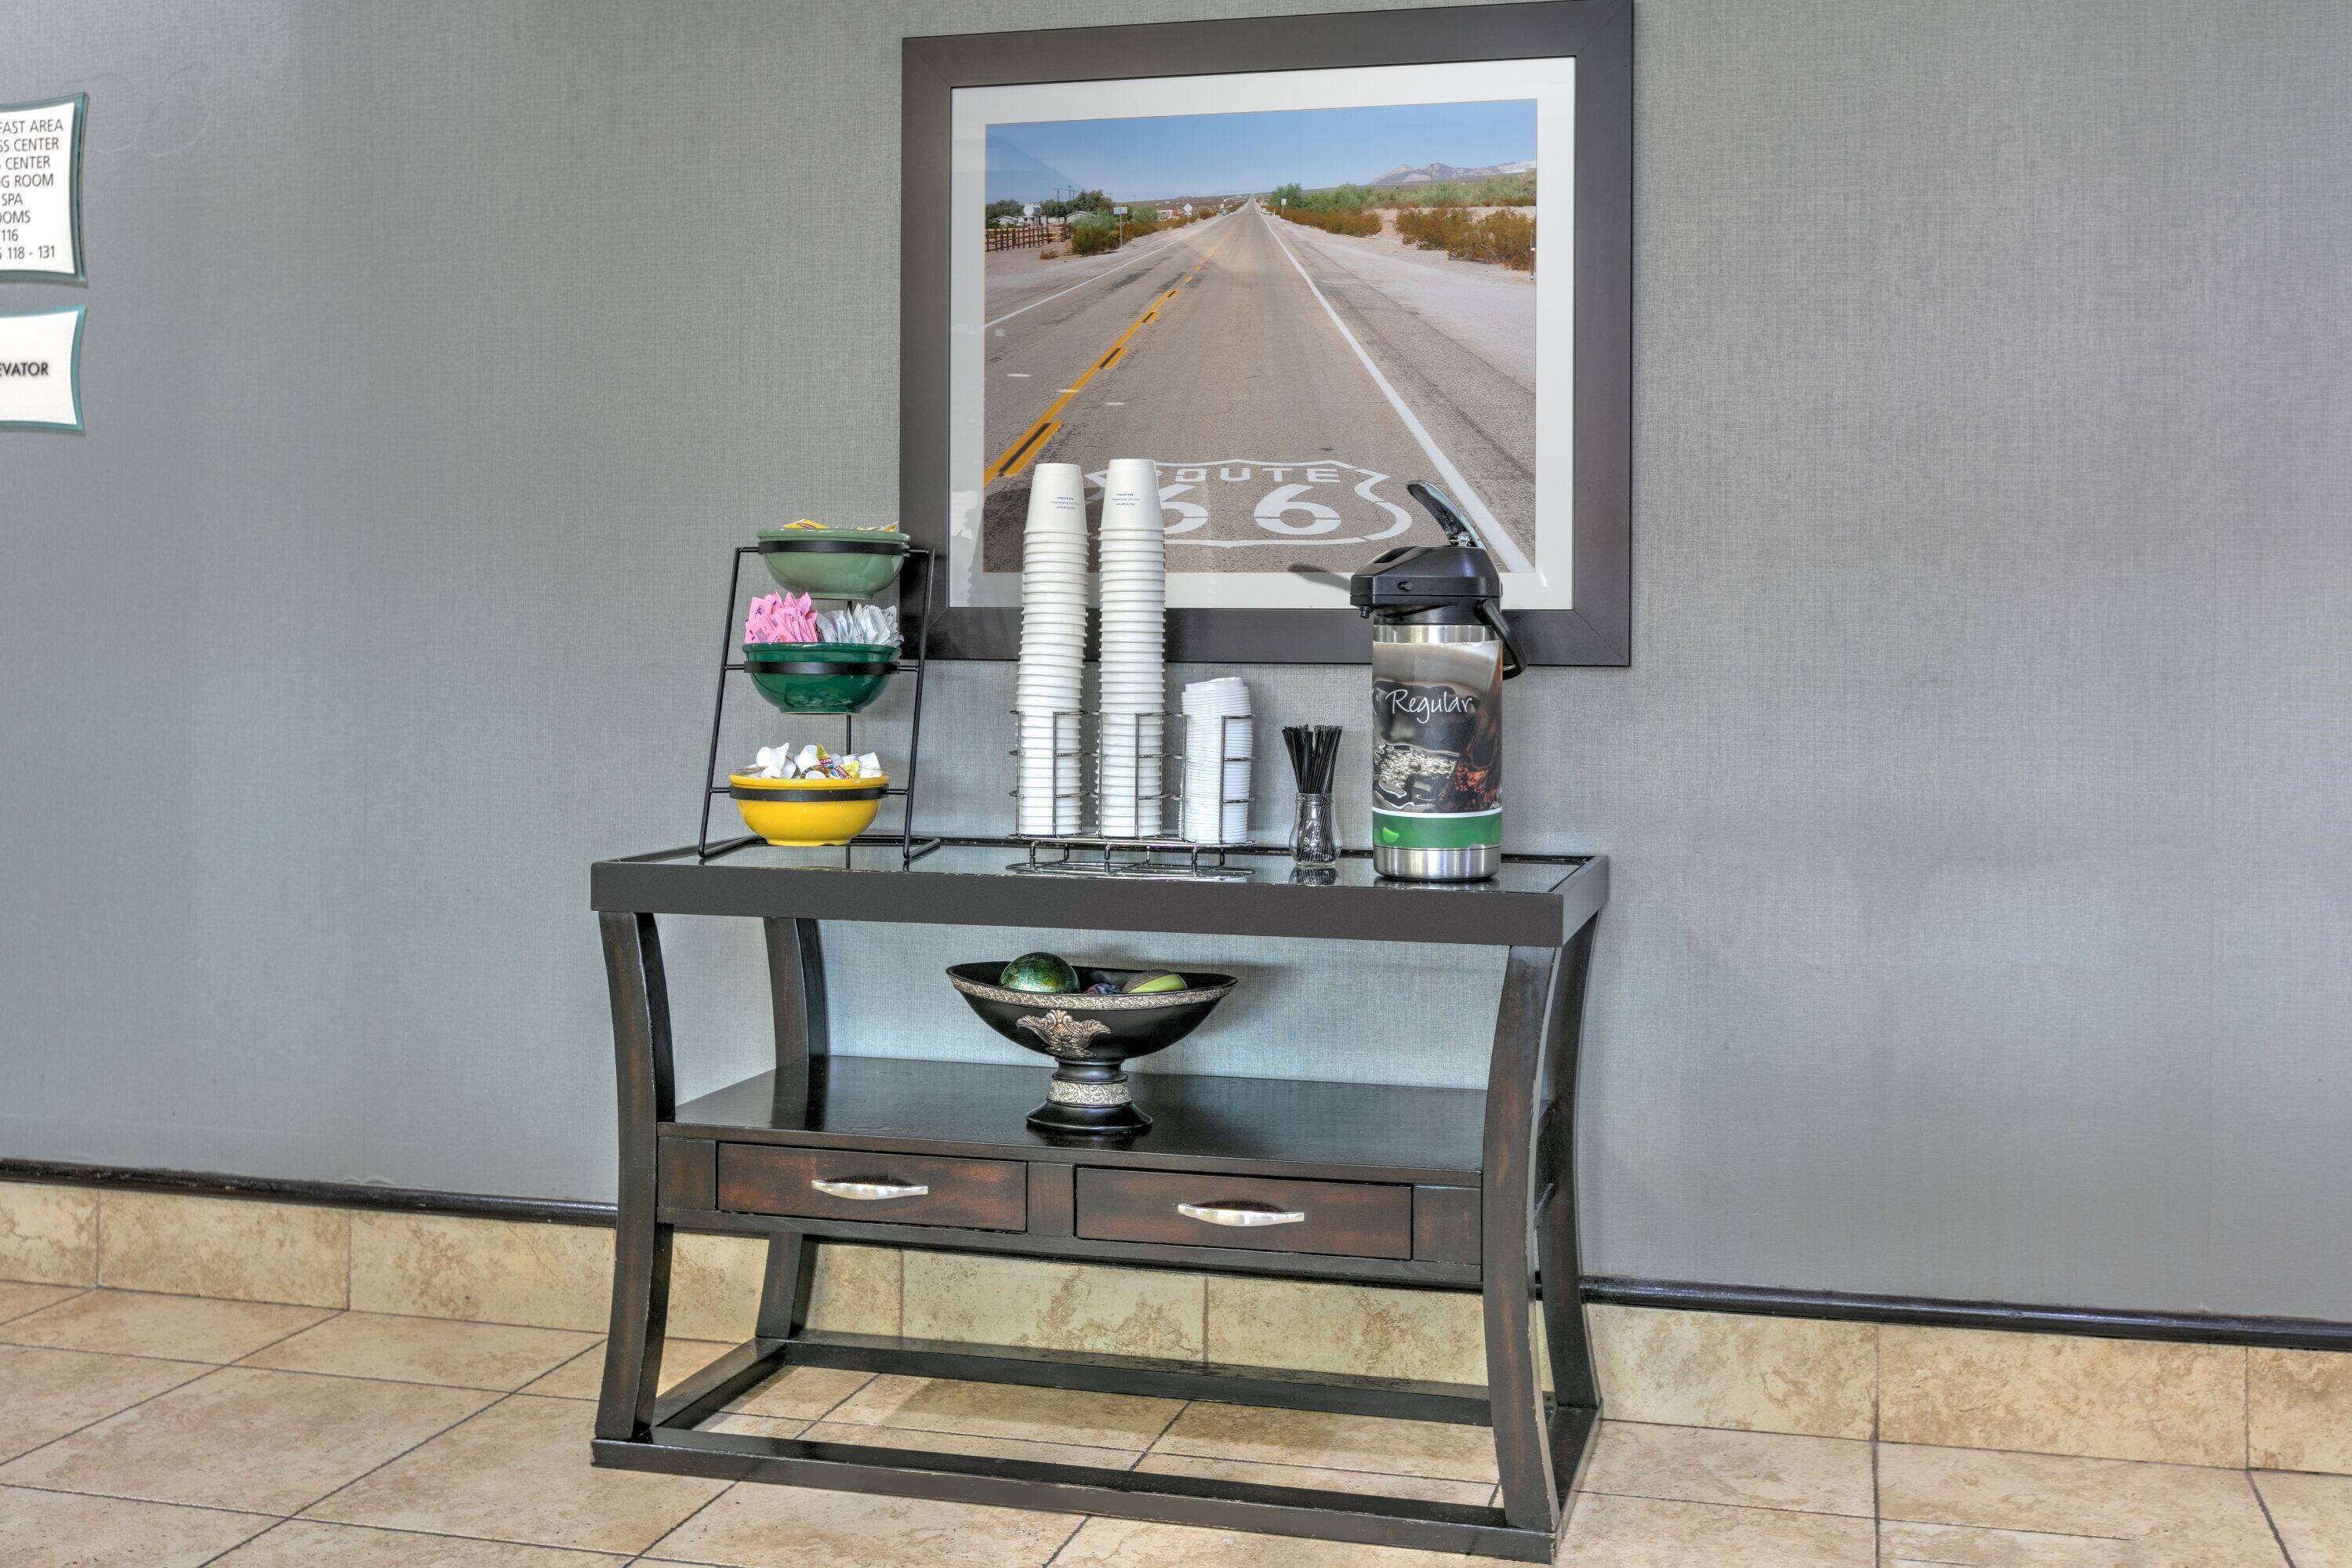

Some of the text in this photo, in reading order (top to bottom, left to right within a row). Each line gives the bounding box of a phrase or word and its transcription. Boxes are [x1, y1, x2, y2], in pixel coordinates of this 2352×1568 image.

[30, 118, 64, 132] AREA
[13, 136, 60, 152] CENTER
[5, 155, 51, 170] CENTER
[14, 173, 53, 187] ROOM
[2, 193, 24, 206] SPA
[0, 210, 31, 224] OMS
[1, 229, 19, 242] 116
[8, 246, 25, 260] 118
[38, 245, 55, 259] 131
[0, 361, 49, 376] VATOR
[1156, 467, 1341, 483] OUTE
[1385, 688, 1473, 724] Regular
